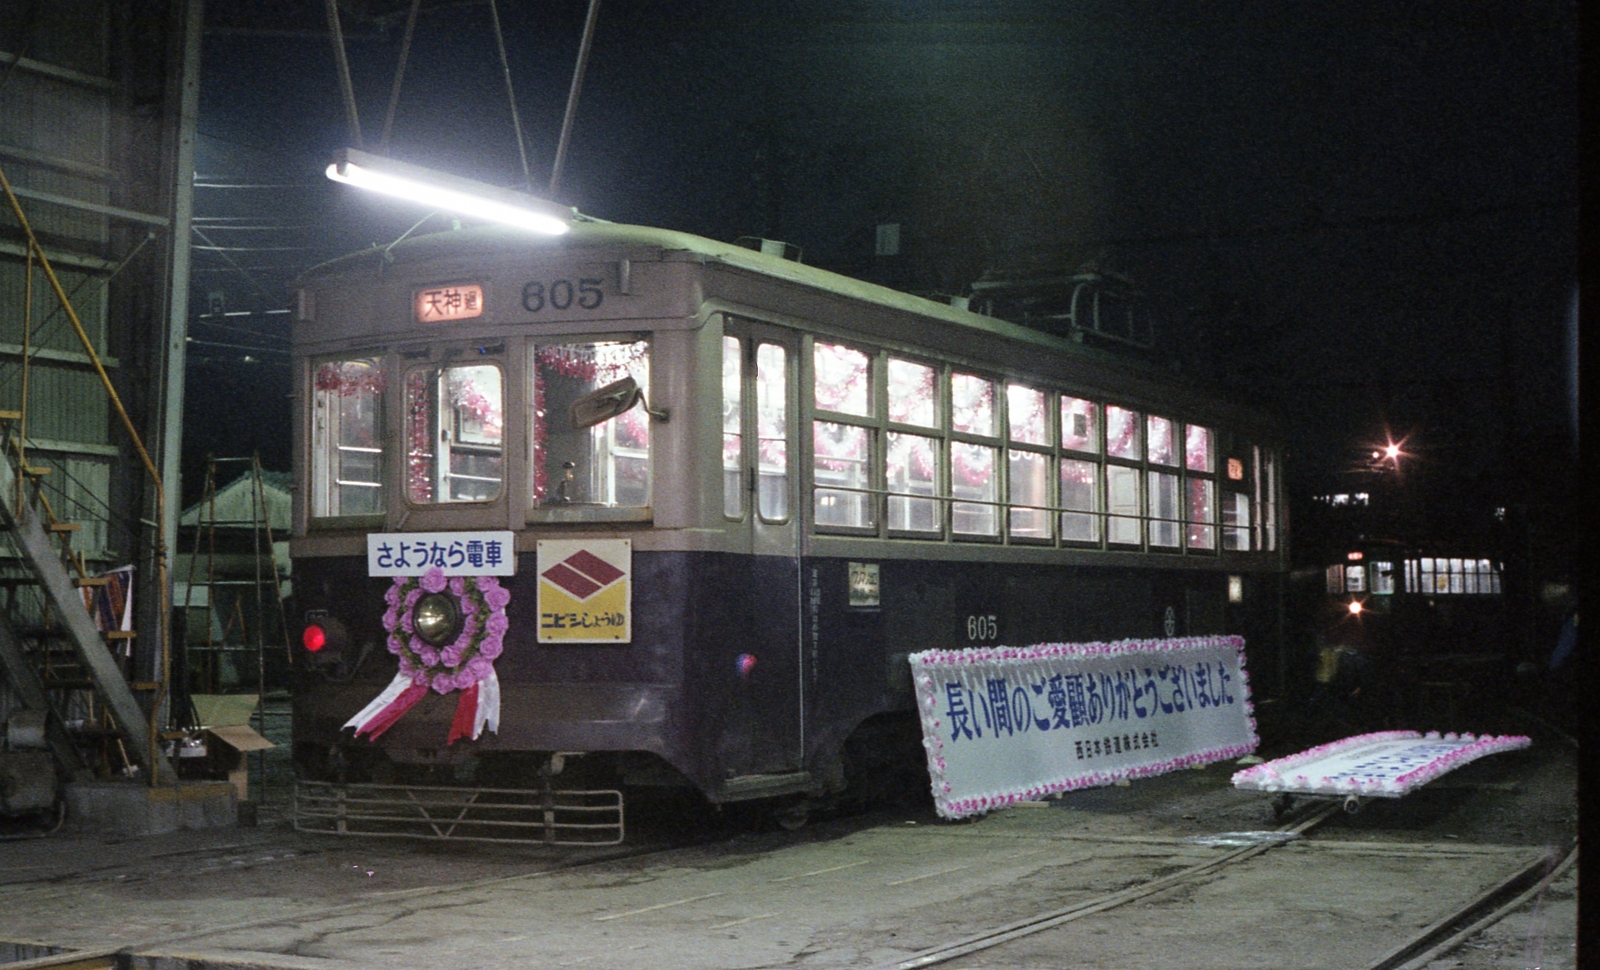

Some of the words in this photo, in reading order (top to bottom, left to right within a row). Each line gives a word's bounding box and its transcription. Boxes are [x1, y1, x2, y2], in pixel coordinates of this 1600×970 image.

[377, 540, 503, 568] さようなら電車
[541, 612, 625, 629] ニビシしょうゆ
[967, 615, 998, 640] 605
[945, 661, 1234, 742] 長い間のご愛顧ありがとうございました
